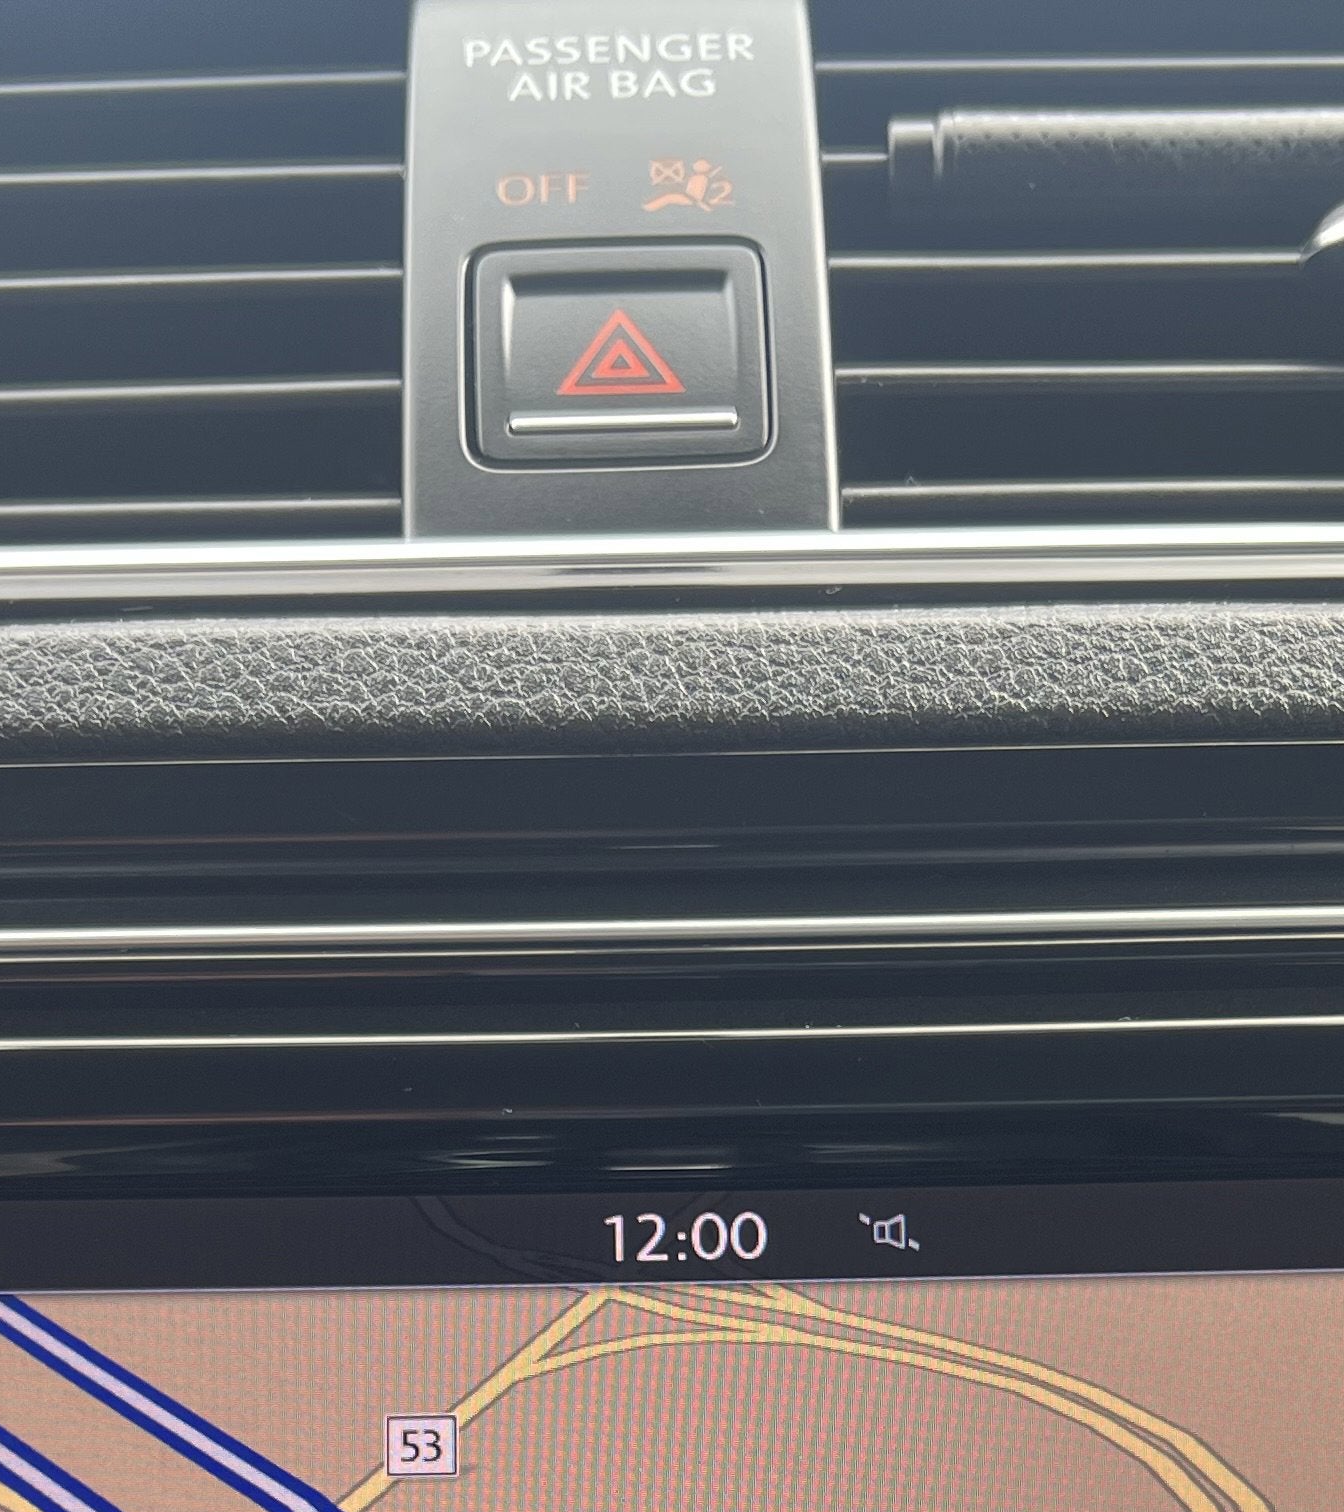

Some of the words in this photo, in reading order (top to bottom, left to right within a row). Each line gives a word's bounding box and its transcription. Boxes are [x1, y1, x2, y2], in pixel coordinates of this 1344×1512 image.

[463, 32, 756, 68] PASSENGER
[508, 72, 590, 101] AIR
[609, 68, 716, 98] BAG
[496, 172, 591, 207] OFF
[602, 1211, 769, 1263] 12:00
[399, 1429, 443, 1464] 53
